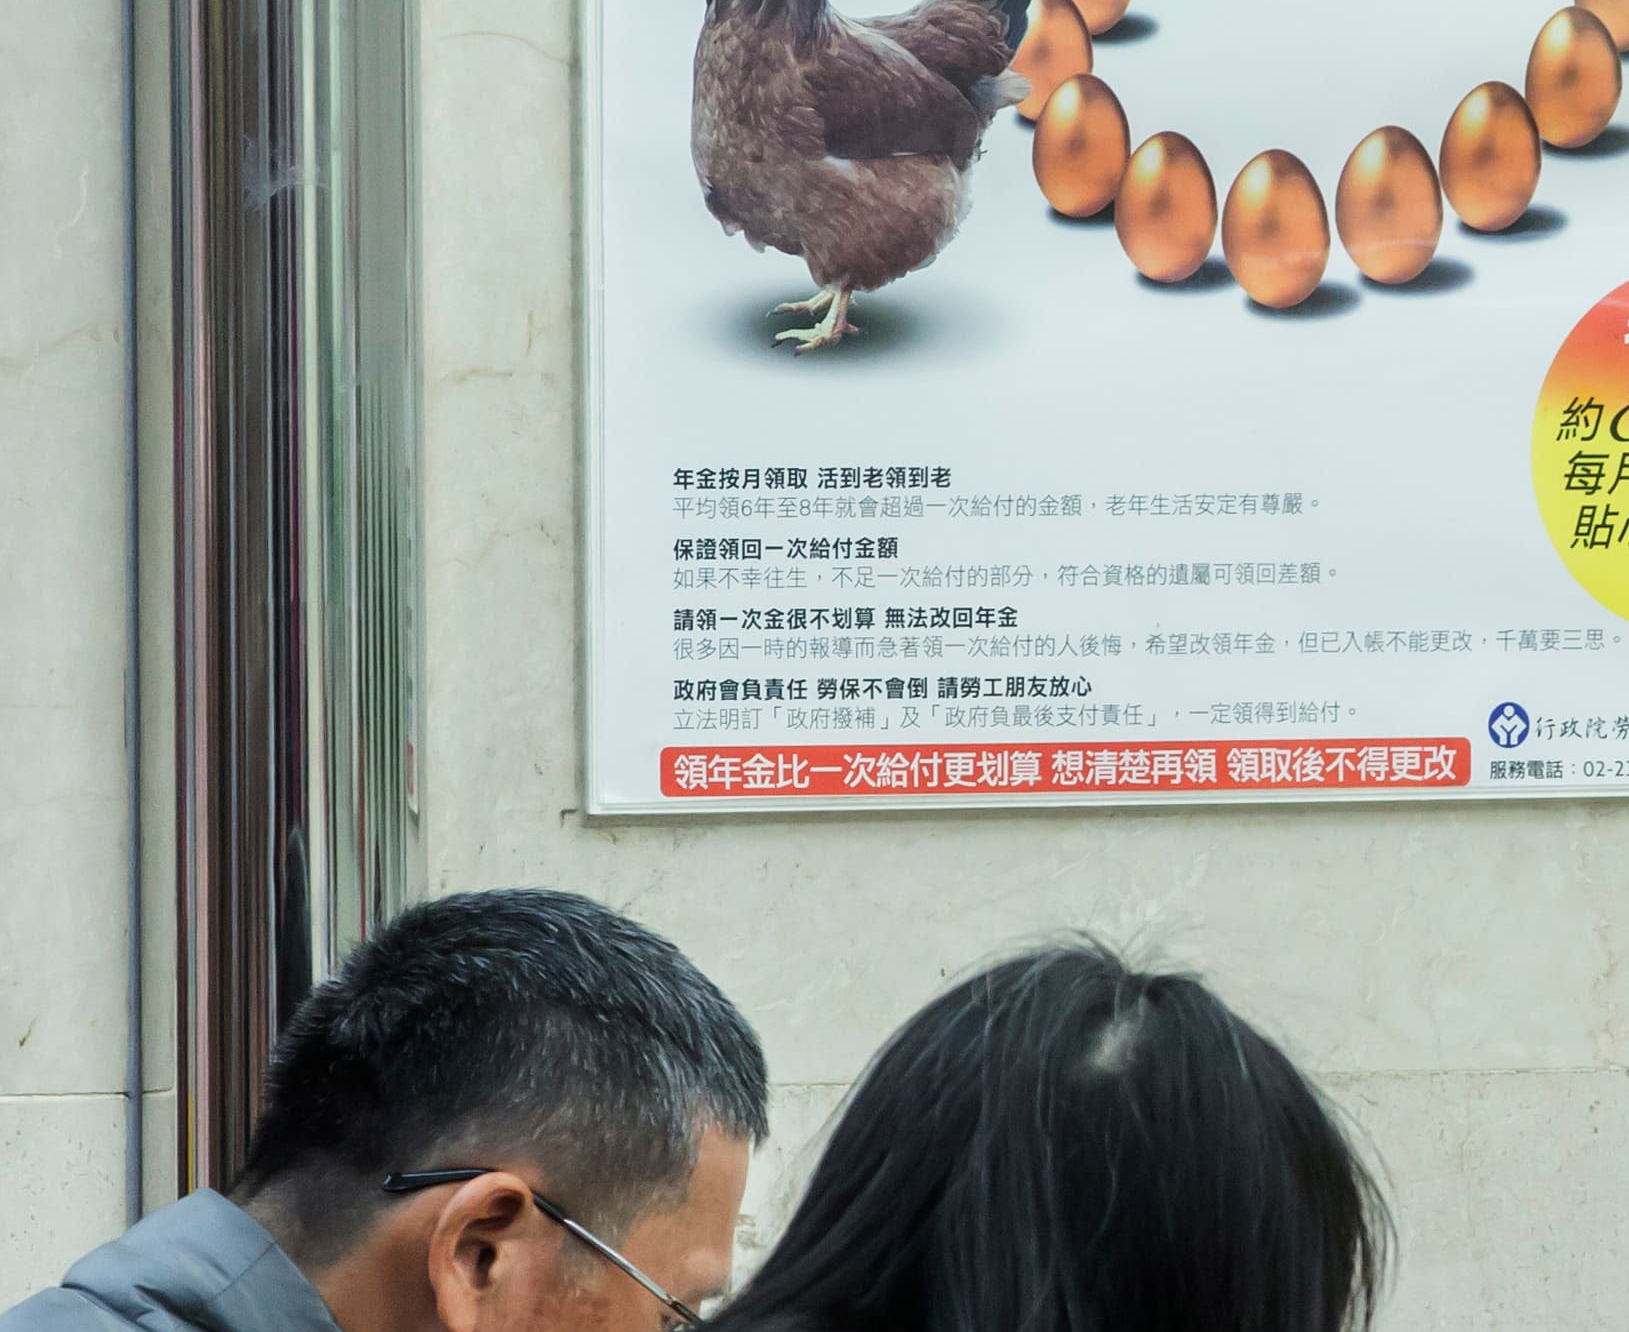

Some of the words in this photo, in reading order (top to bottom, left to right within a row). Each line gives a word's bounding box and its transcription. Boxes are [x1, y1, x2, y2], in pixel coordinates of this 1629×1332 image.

[672, 467, 808, 491] 年金按月領取
[817, 465, 952, 490] 活到老領到老
[673, 536, 899, 562] 保證領回一次給付金額
[673, 606, 876, 632] 請領一次金很不划算
[884, 605, 1018, 629] 無法改回年金
[673, 677, 808, 702] 政府會負責任
[816, 676, 928, 701] 勞保不會倒
[937, 675, 1093, 700] 請勞工朋友放心
[673, 749, 1043, 790] 領年金比一次給付更划算
[1051, 748, 1217, 786] 想清楚再領
[1227, 743, 1457, 783] 領取後不得更改
